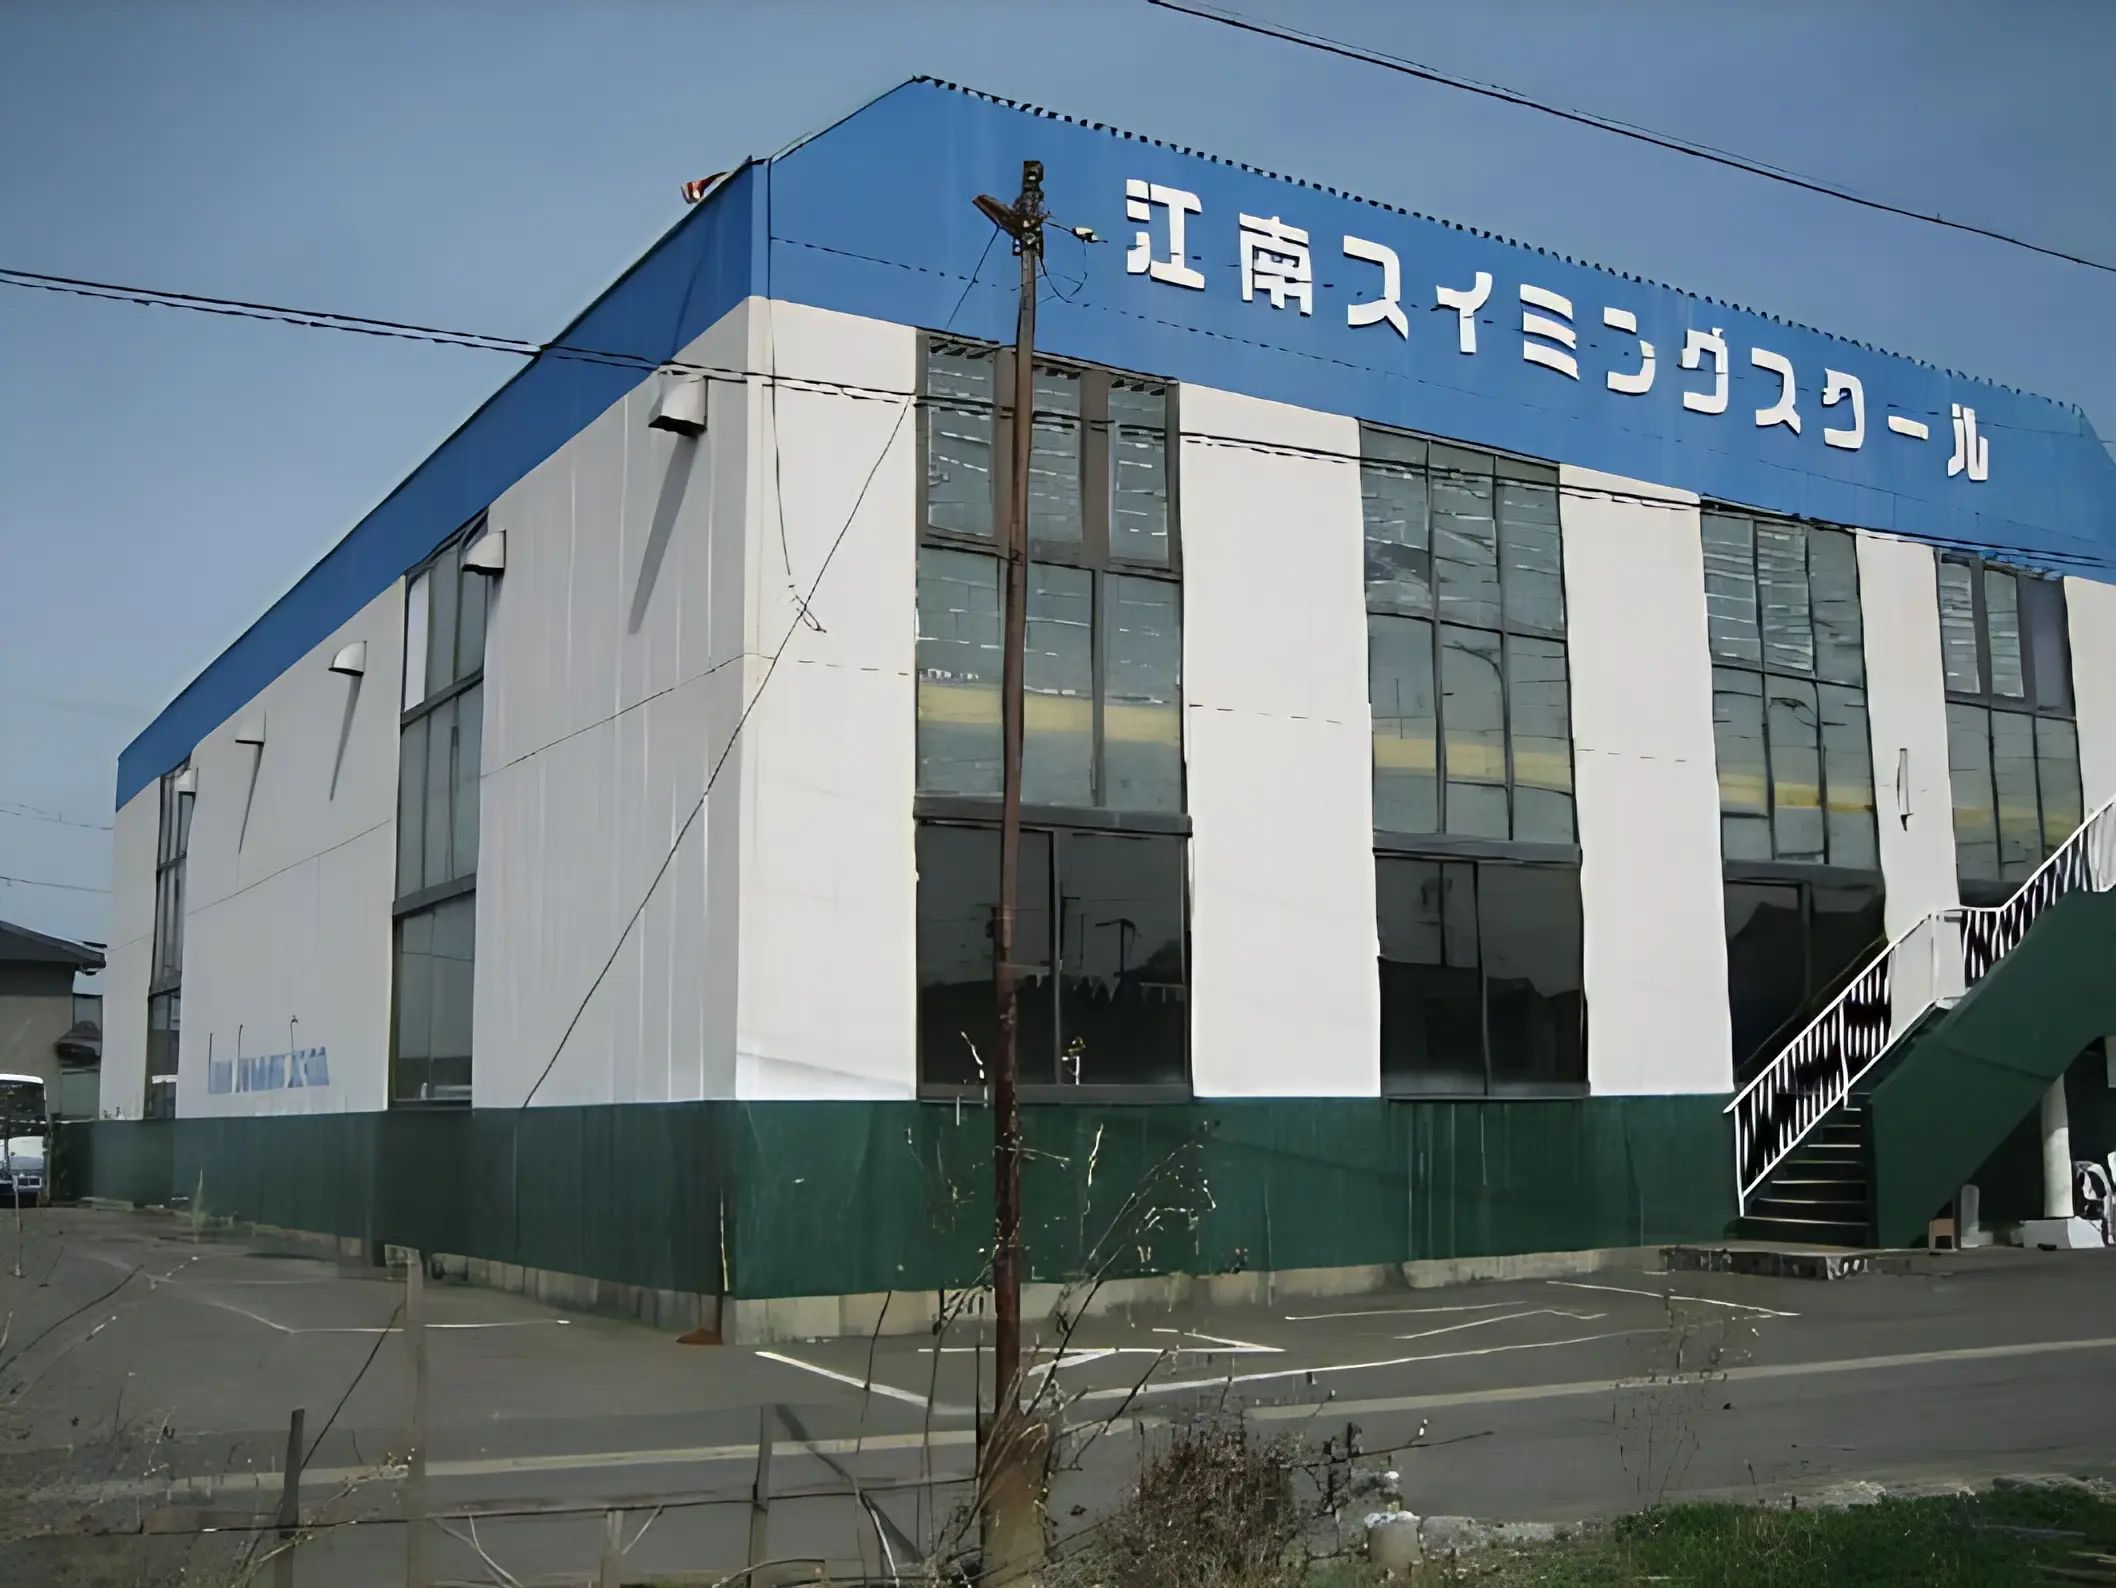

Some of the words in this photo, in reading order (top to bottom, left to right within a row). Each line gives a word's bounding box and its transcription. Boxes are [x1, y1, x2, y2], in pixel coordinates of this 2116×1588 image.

[1126, 178, 1989, 482] 江南スイミングスクール
